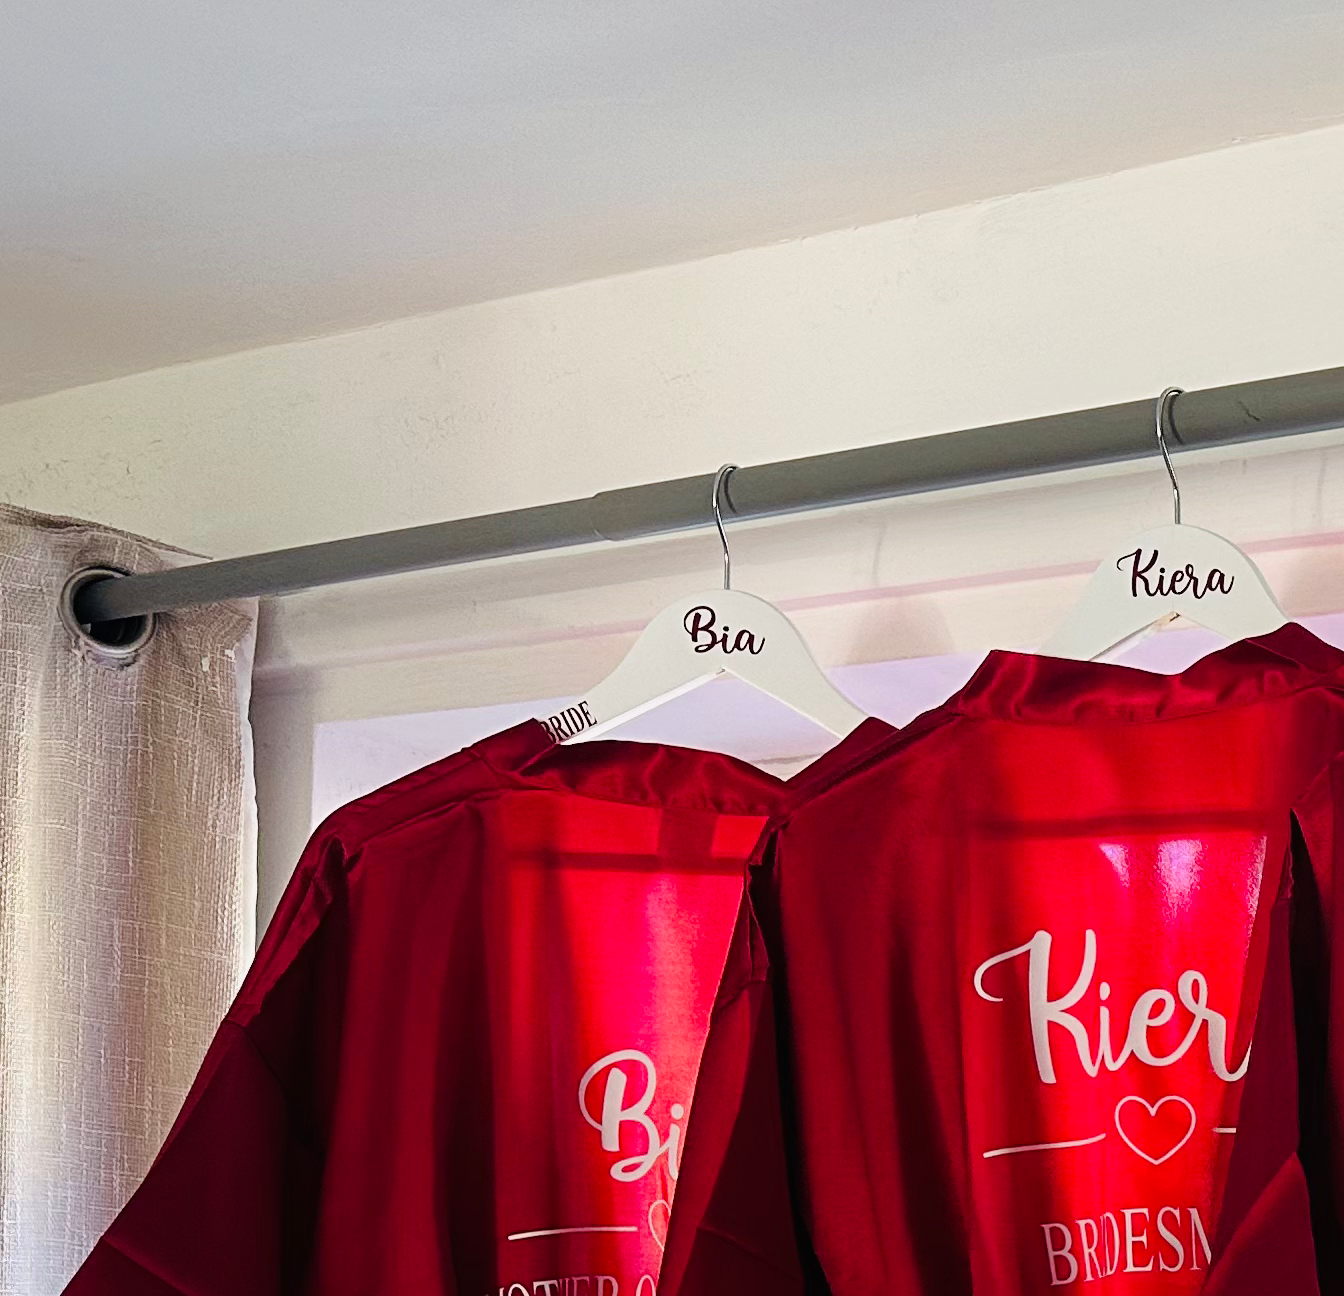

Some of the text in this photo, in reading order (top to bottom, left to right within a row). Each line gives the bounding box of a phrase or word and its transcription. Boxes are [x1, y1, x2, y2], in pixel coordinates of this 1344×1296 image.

[1117, 548, 1234, 599] Kiera
[684, 606, 765, 654] Bia
[974, 928, 1253, 1084] Kier
[579, 1049, 686, 1182] Bi
